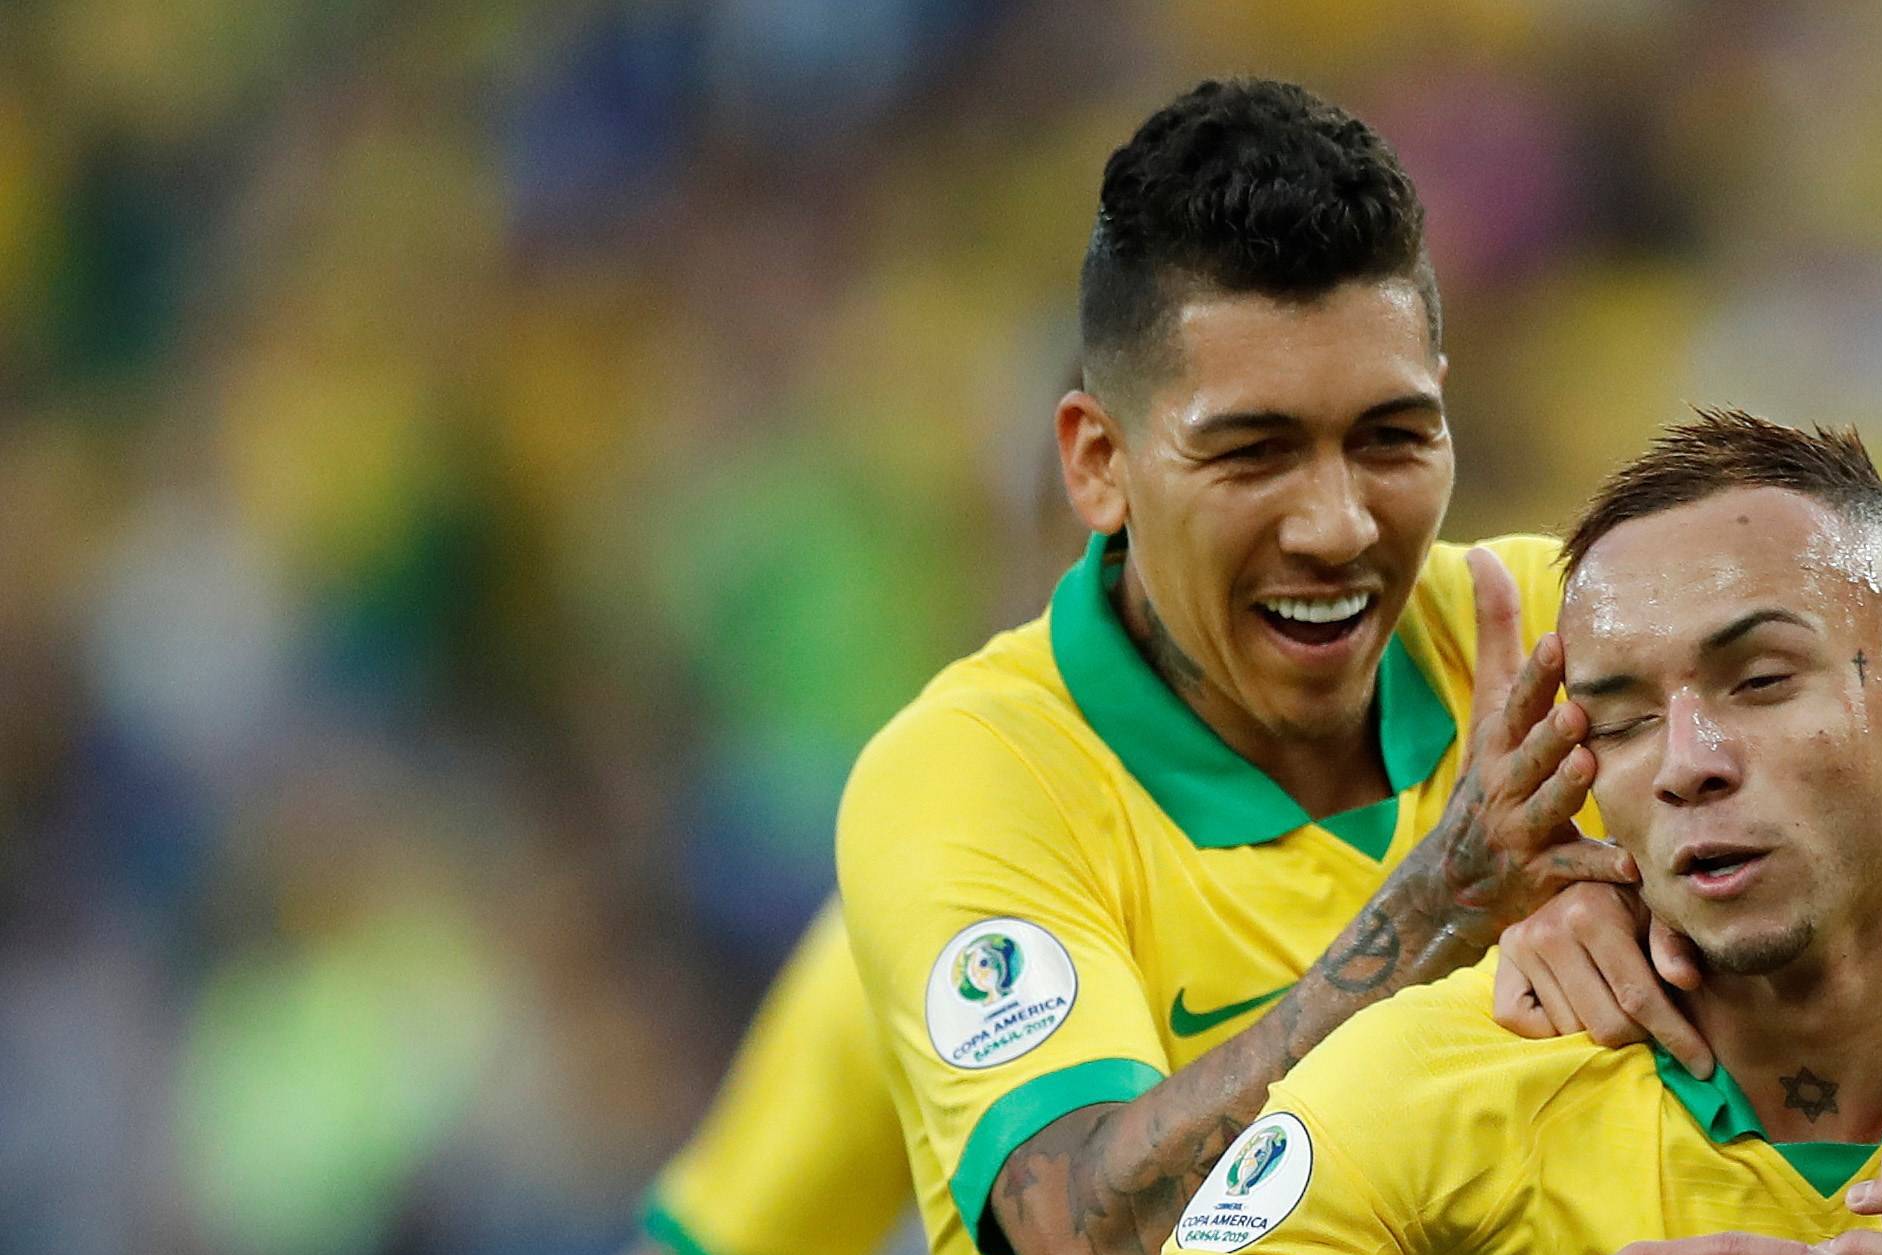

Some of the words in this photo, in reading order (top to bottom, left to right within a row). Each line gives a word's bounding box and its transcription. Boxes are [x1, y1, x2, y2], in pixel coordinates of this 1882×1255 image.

[953, 1030, 990, 1060] COPA
[994, 996, 1066, 1032] AMERICA
[1024, 1015, 1056, 1034] 2019
[1182, 1214, 1209, 1228] COPA
[1210, 1214, 1268, 1229] AMERICA
[1222, 1230, 1249, 1243] 2019
